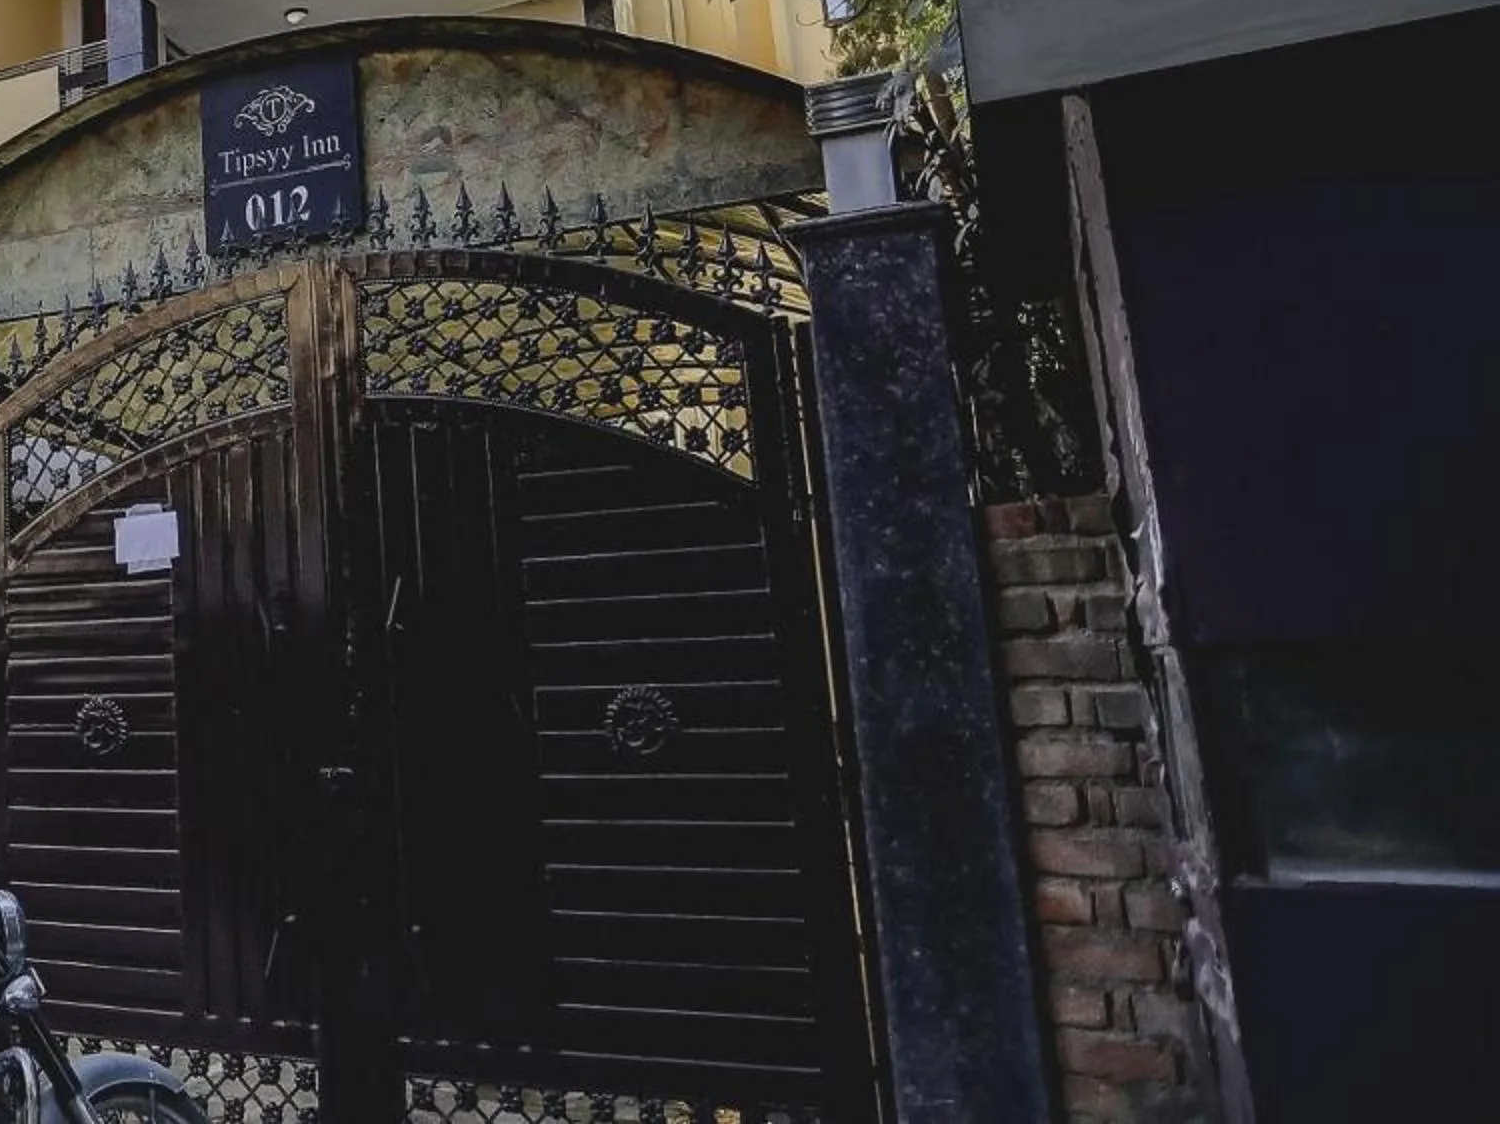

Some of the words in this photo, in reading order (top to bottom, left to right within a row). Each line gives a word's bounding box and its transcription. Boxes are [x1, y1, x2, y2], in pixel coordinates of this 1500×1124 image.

[217, 144, 294, 177] Tipsyy
[302, 134, 341, 159] Inn
[245, 185, 311, 231] 012
